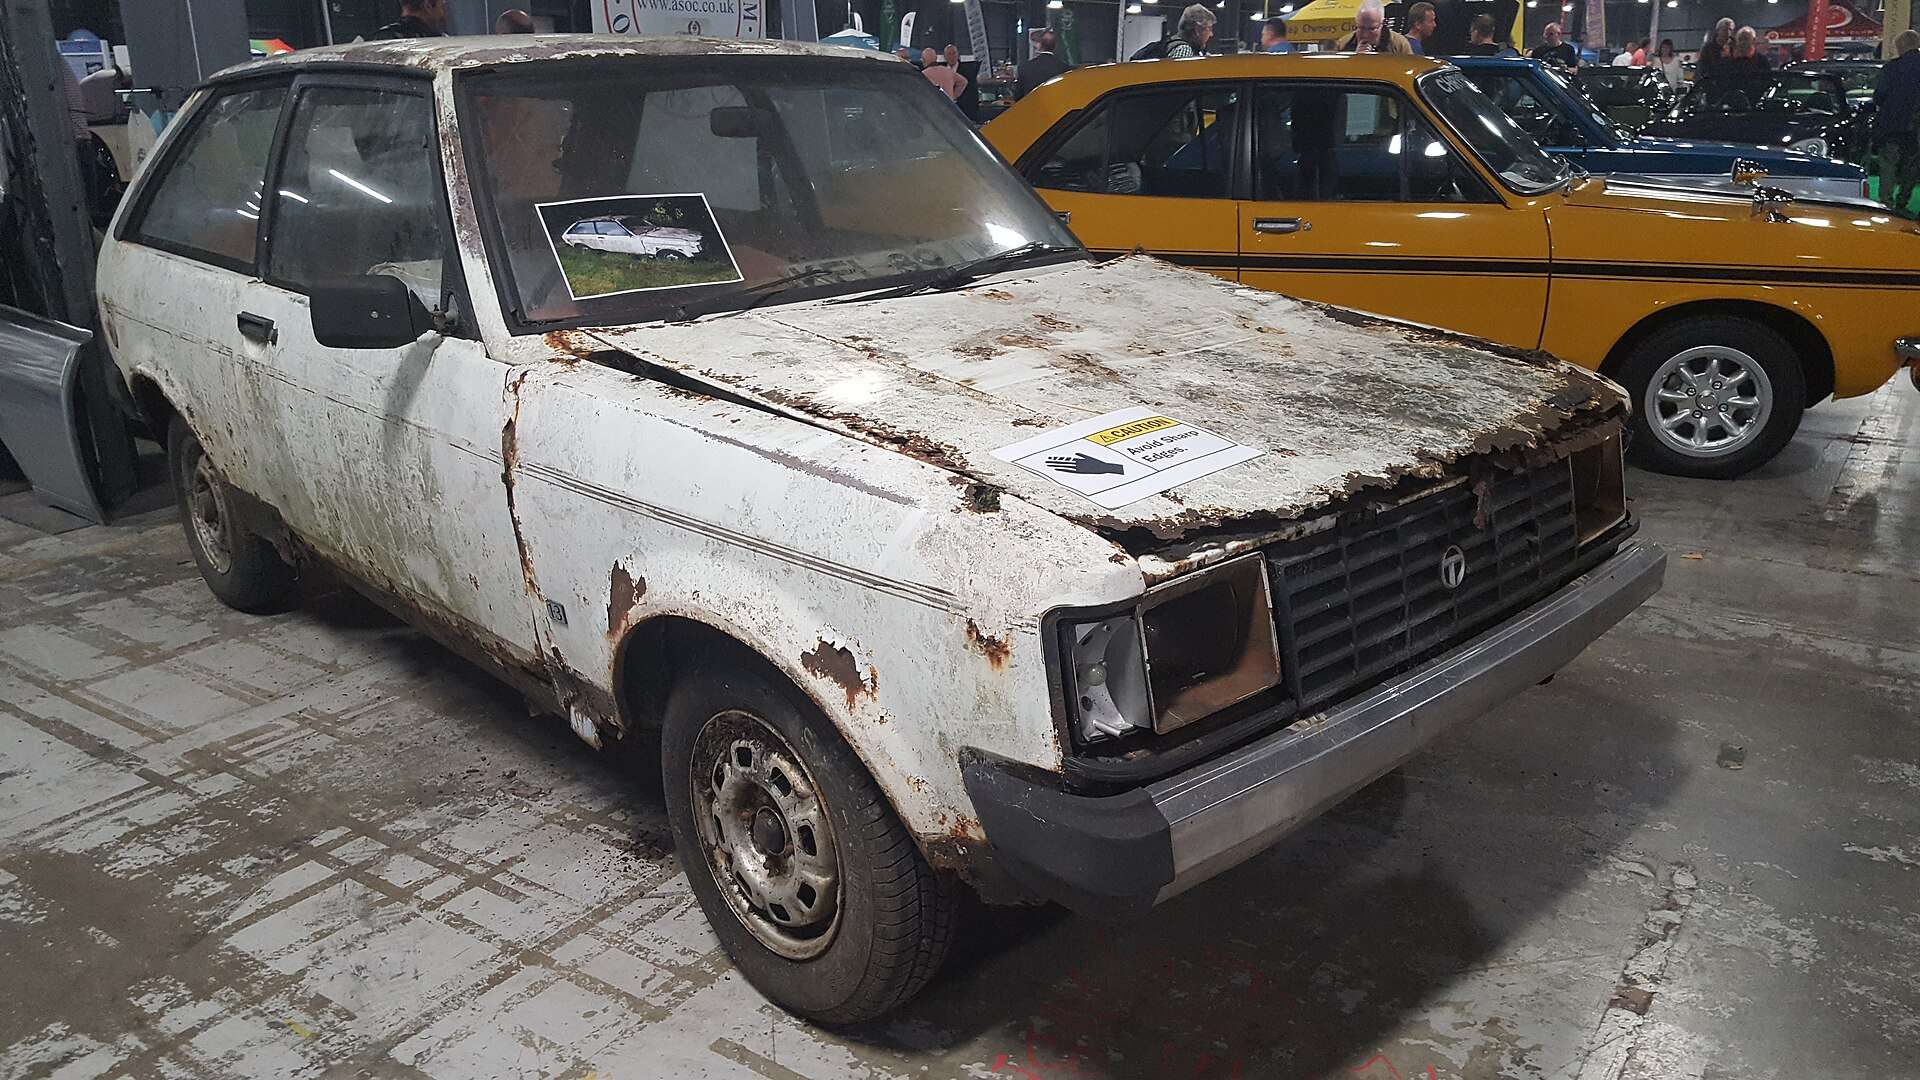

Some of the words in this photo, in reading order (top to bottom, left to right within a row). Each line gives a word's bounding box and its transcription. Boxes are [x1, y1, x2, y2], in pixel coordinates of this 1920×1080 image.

[637, 0, 735, 14] www.asoc.co.uk
[1111, 418, 1172, 439] CAUTION
[1127, 439, 1164, 455] Avoid
[1160, 430, 1199, 443] Sharp
[1142, 446, 1188, 463] Edges.
